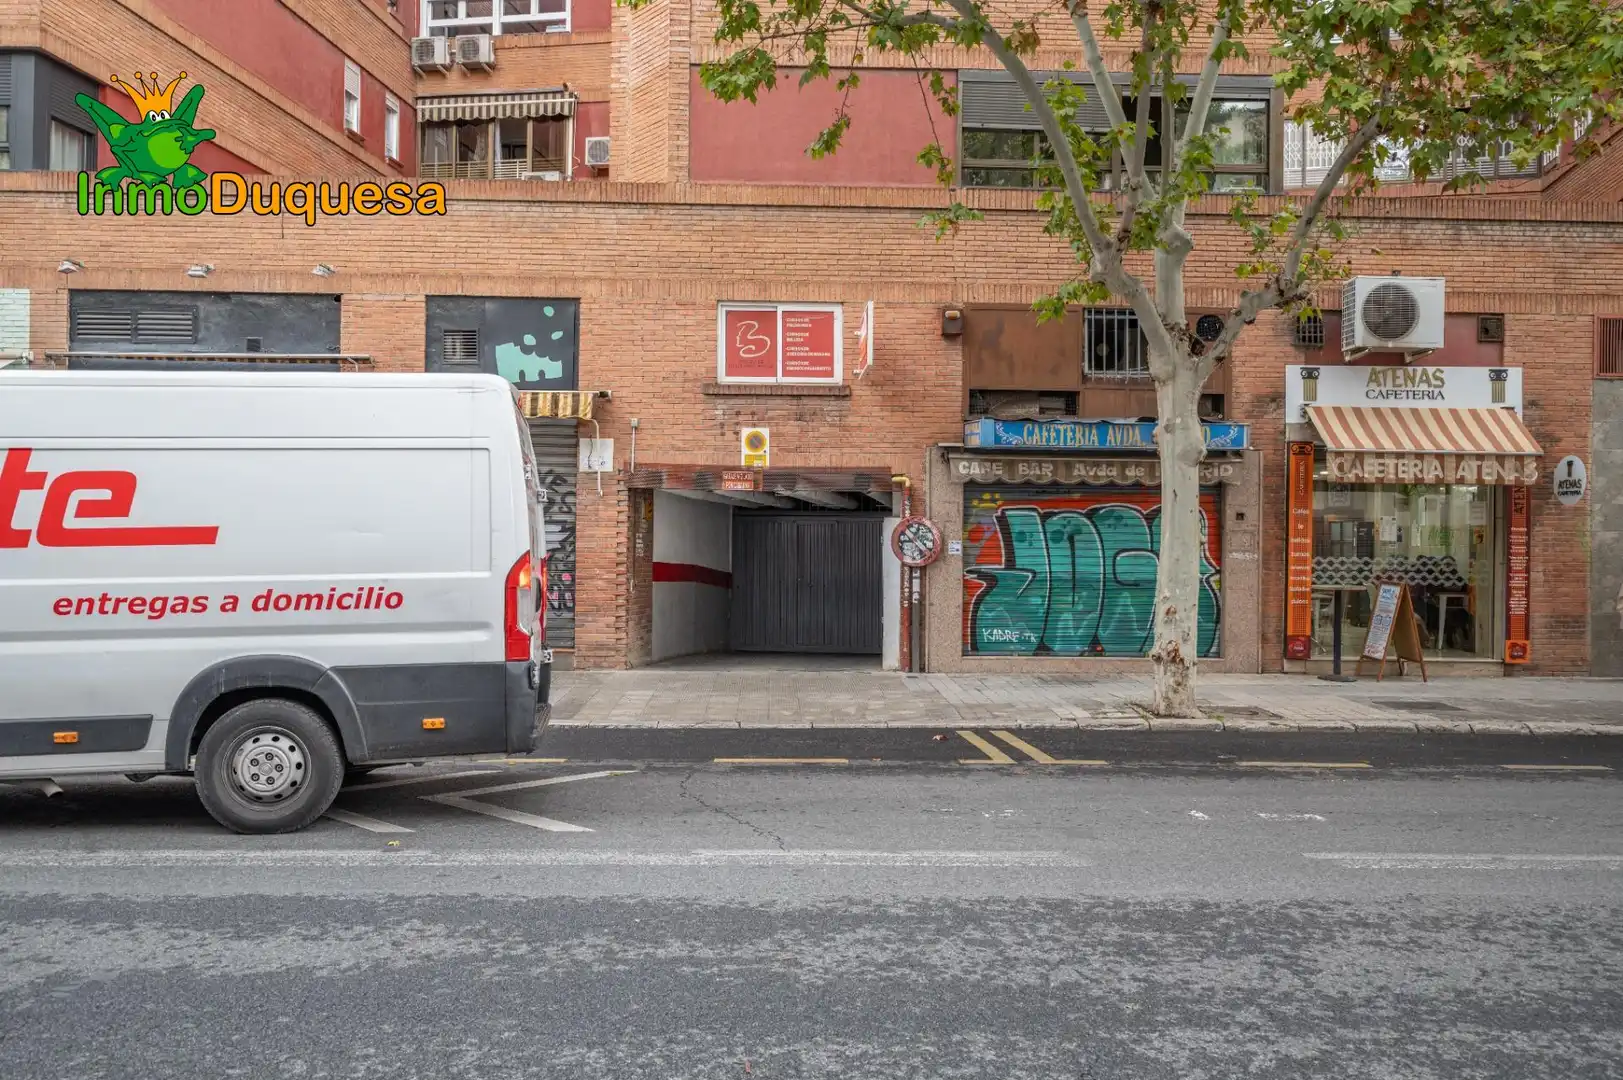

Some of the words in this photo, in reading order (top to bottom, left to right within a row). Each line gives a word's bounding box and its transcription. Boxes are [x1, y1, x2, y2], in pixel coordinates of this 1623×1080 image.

[1366, 367, 1446, 388] ATENAS
[1365, 389, 1446, 401] CAFETERIA
[958, 461, 1003, 475] CAFE
[1018, 463, 1054, 477] BAR
[1072, 463, 1117, 476] Avda
[1125, 464, 1144, 477] de
[1331, 457, 1444, 479] CAFETERIA
[1456, 460, 1538, 482] ATENAS
[1557, 479, 1583, 490] ATENAS
[1513, 484, 1524, 515] ATEN
[52, 592, 209, 620] entregas
[219, 593, 239, 613] a
[251, 586, 404, 612] domicilio
